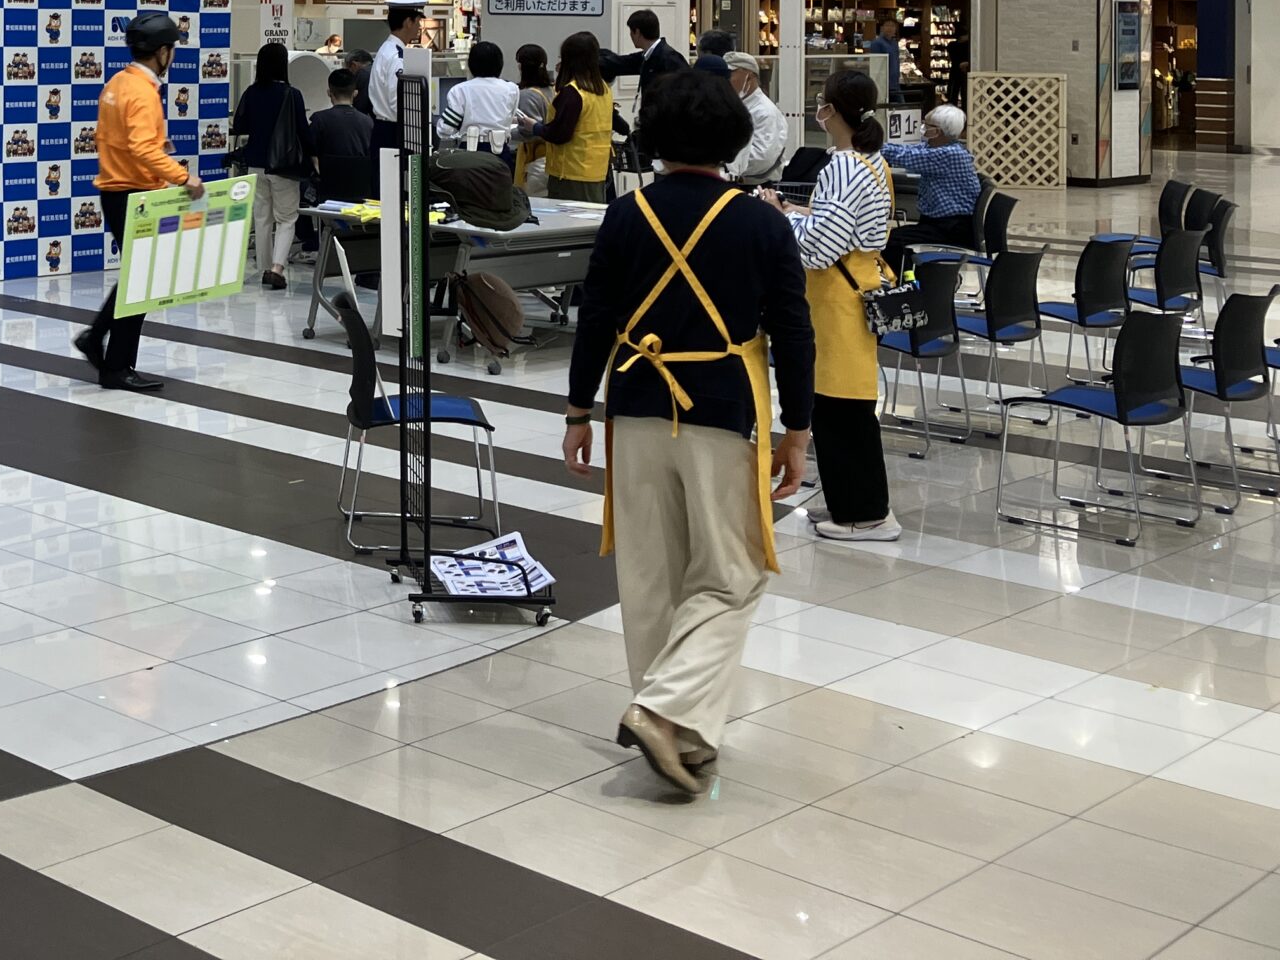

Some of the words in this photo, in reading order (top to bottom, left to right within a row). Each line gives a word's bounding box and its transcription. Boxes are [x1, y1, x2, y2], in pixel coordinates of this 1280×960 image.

[494, 0, 596, 12] ご利用いただけます。
[264, 29, 288, 37] GRAND
[905, 114, 918, 135] 1F
